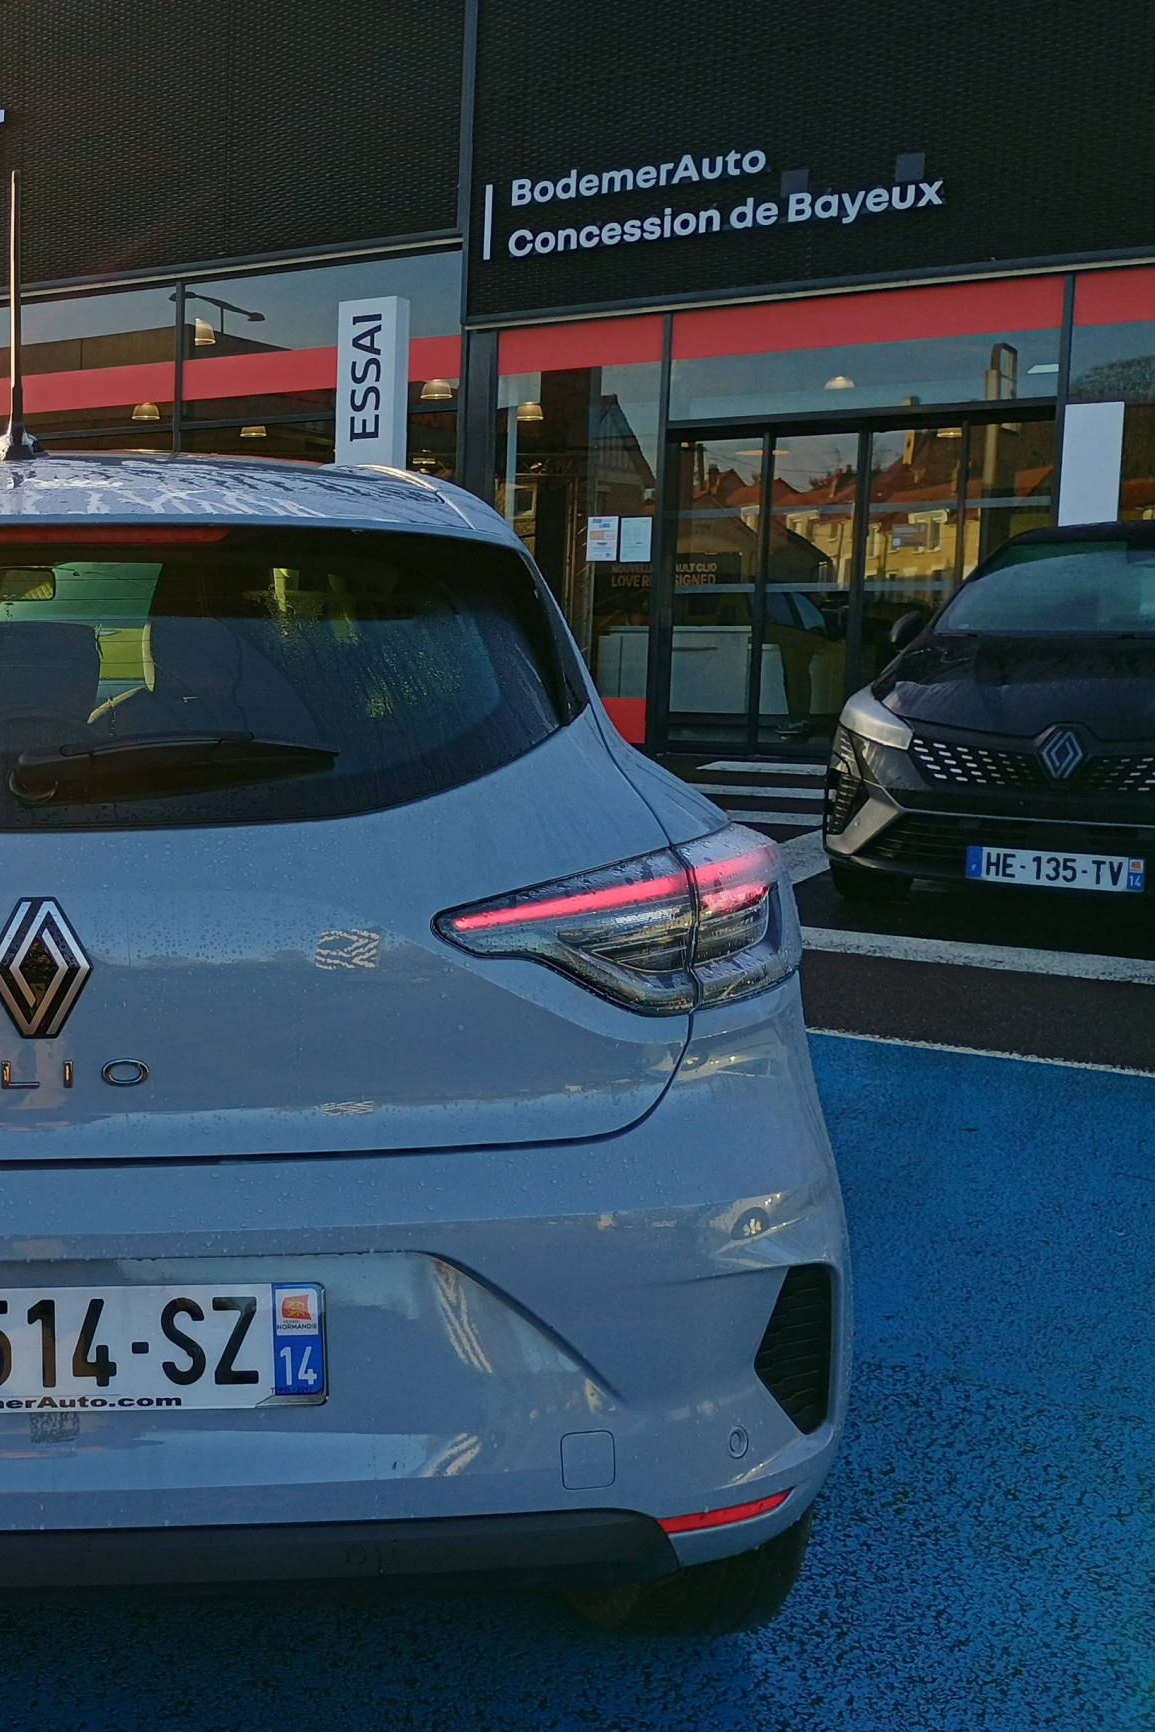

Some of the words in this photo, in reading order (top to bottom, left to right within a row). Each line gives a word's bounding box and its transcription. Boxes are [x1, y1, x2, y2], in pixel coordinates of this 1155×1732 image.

[510, 149, 767, 207] BodemerAuto
[507, 207, 721, 257] Concession
[729, 197, 779, 229] de
[787, 180, 944, 225] Bayeux
[349, 313, 383, 442] ESSAI
[611, 575, 640, 588] LOVE
[696, 562, 718, 573] CLIO
[984, 851, 1124, 886] HE-135-TV
[1129, 875, 1141, 887] 14
[276, 1323, 318, 1331] NORMANDIE
[279, 1346, 318, 1386] 14
